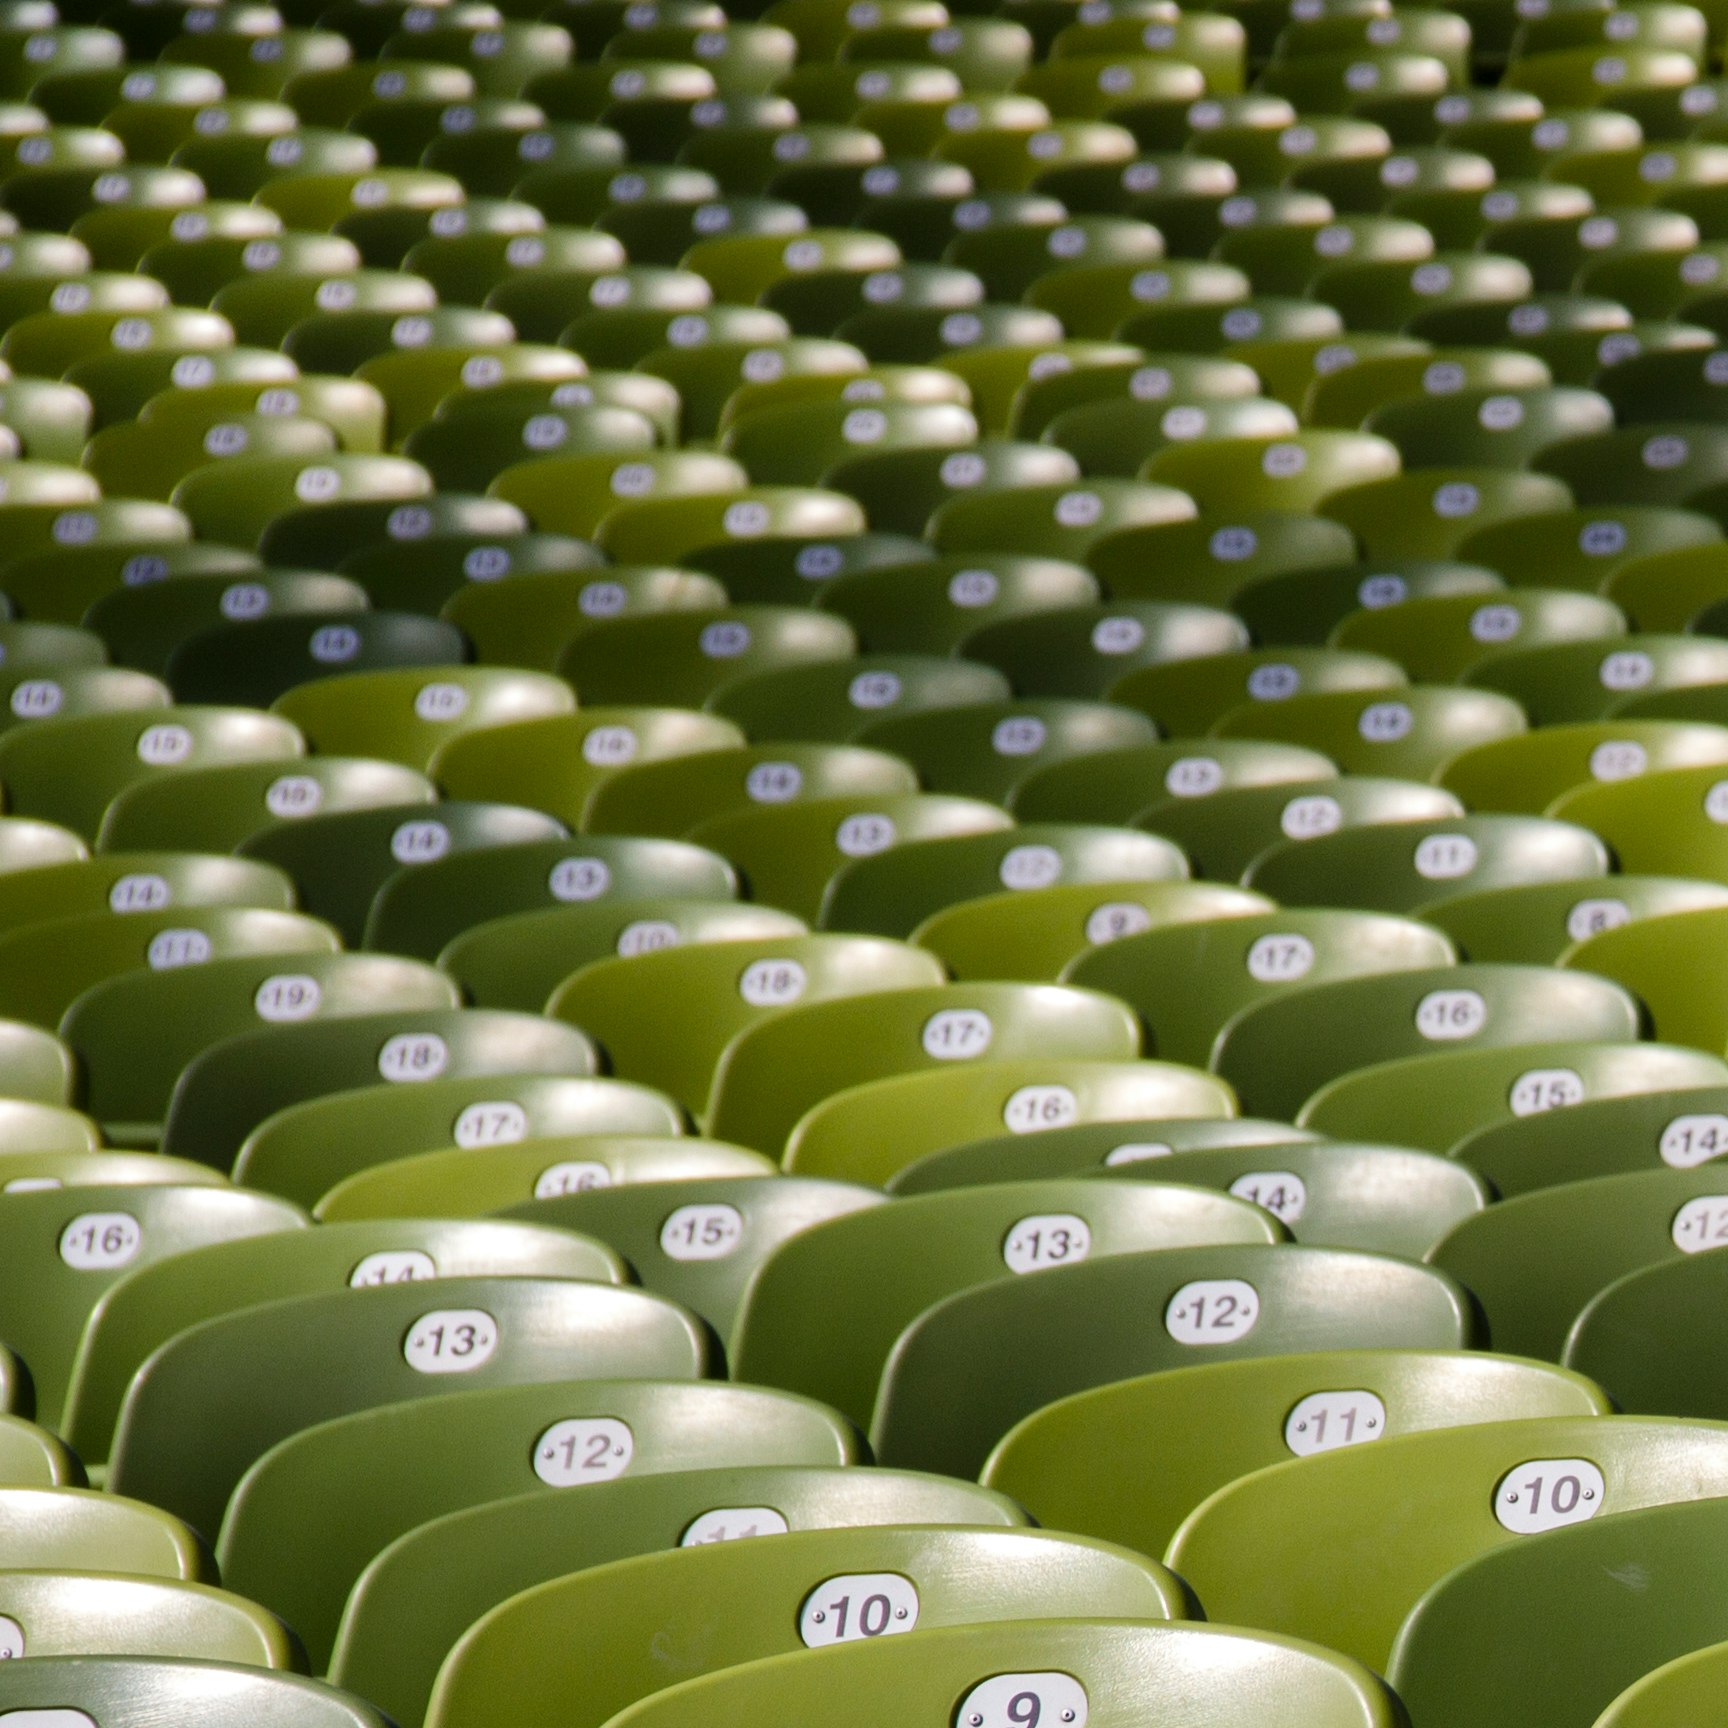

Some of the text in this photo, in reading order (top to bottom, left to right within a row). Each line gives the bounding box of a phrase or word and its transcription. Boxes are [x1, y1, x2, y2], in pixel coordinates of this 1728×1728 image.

[1265, 944, 1298, 969] 17
[1436, 1001, 1470, 1025] 16
[941, 1020, 976, 1046] 17
[1027, 1096, 1062, 1122] 16
[1532, 1083, 1571, 1110] 15
[475, 1113, 510, 1139] 17
[1683, 1127, 1718, 1153] 14
[85, 1225, 124, 1254] 16
[685, 1217, 724, 1246] 15
[1028, 1229, 1071, 1261] 13
[1189, 1295, 1238, 1330] 12
[430, 1324, 477, 1357] 13
[1310, 1407, 1357, 1444] 11
[559, 1433, 612, 1470] 12
[1524, 1474, 1582, 1515] 10
[827, 1594, 893, 1638] 10
